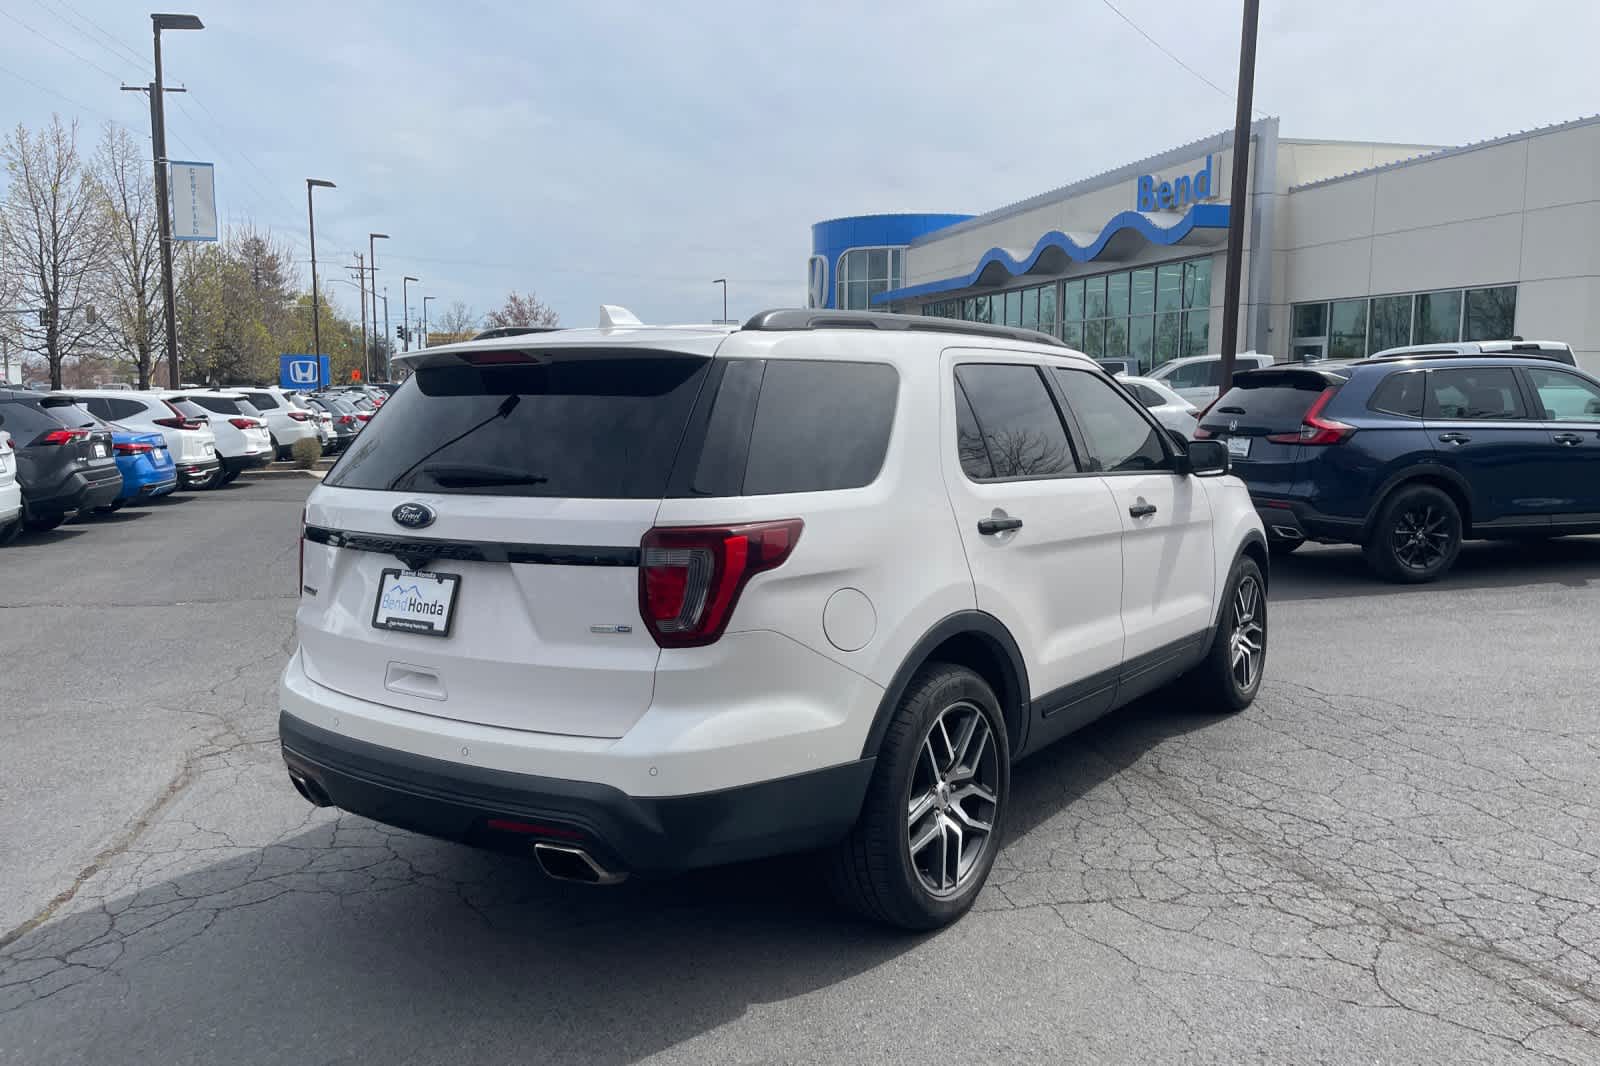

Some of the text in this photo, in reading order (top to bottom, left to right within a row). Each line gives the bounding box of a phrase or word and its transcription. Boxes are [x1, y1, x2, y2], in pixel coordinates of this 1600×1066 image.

[1137, 153, 1212, 212] Bend
[396, 505, 423, 522] Ford
[417, 570, 437, 579] Honda
